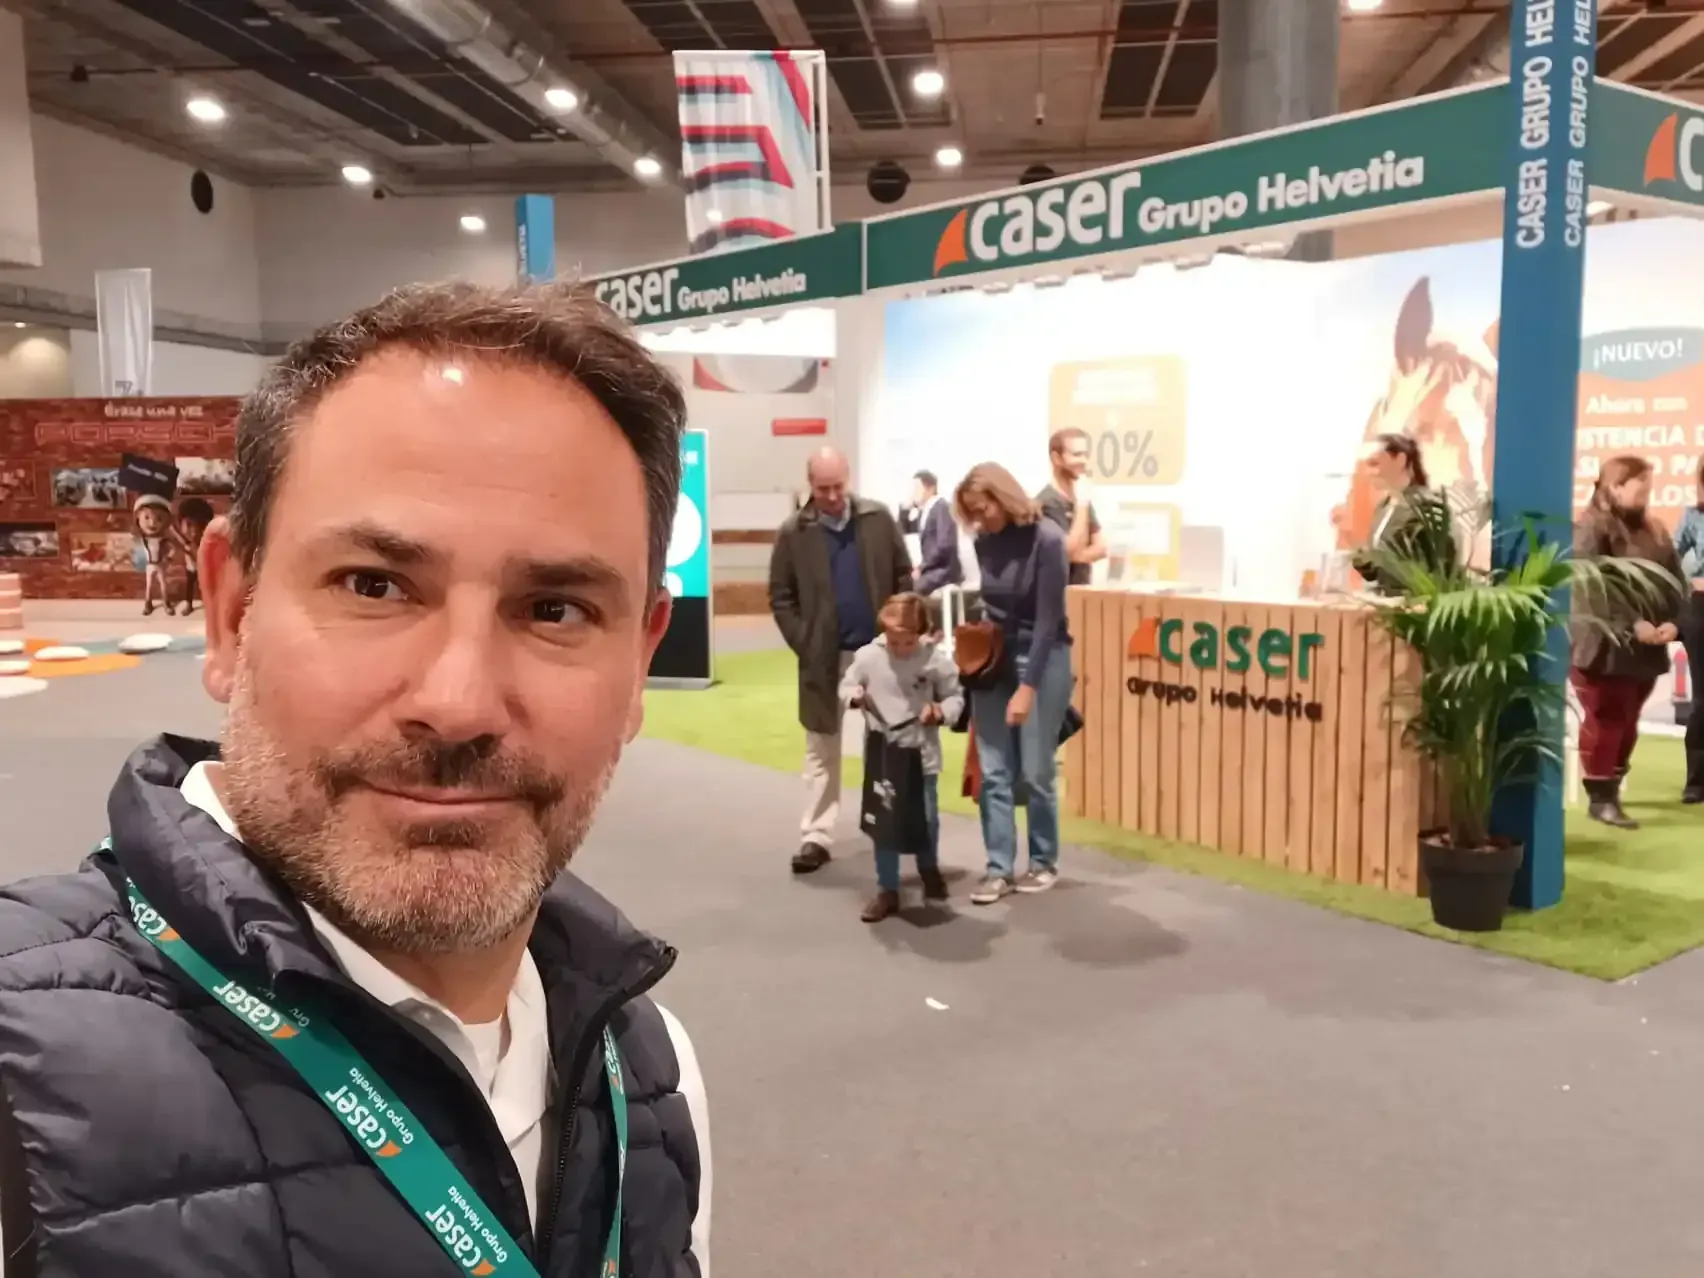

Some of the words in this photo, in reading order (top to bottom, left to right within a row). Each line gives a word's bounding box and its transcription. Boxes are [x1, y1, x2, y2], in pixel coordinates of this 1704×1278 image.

[1525, 0, 1554, 47] HEL
[1520, 55, 1553, 149] GRUPO
[1568, 56, 1590, 148] GRUPO
[970, 171, 1141, 261] caser
[1139, 190, 1248, 233] Grupo
[1258, 150, 1424, 213] Helvetia
[1516, 158, 1548, 248] CASER
[1564, 158, 1585, 247] CASER
[595, 268, 679, 319] caser
[677, 286, 730, 313] Grupo
[732, 267, 807, 302] Helvetia
[1593, 338, 1684, 368] ¡NUEVO!
[1159, 618, 1325, 680] caser
[1127, 676, 1198, 707] Grupo
[1210, 685, 1323, 722] Helvetia
[213, 980, 281, 1032] caser
[349, 1067, 389, 1113] Helvetia
[325, 1085, 387, 1149] caser
[386, 1109, 414, 1145] Grupo
[447, 1185, 484, 1231] Helvetia
[425, 1204, 482, 1268] caser
[481, 1228, 509, 1264] Grupo
